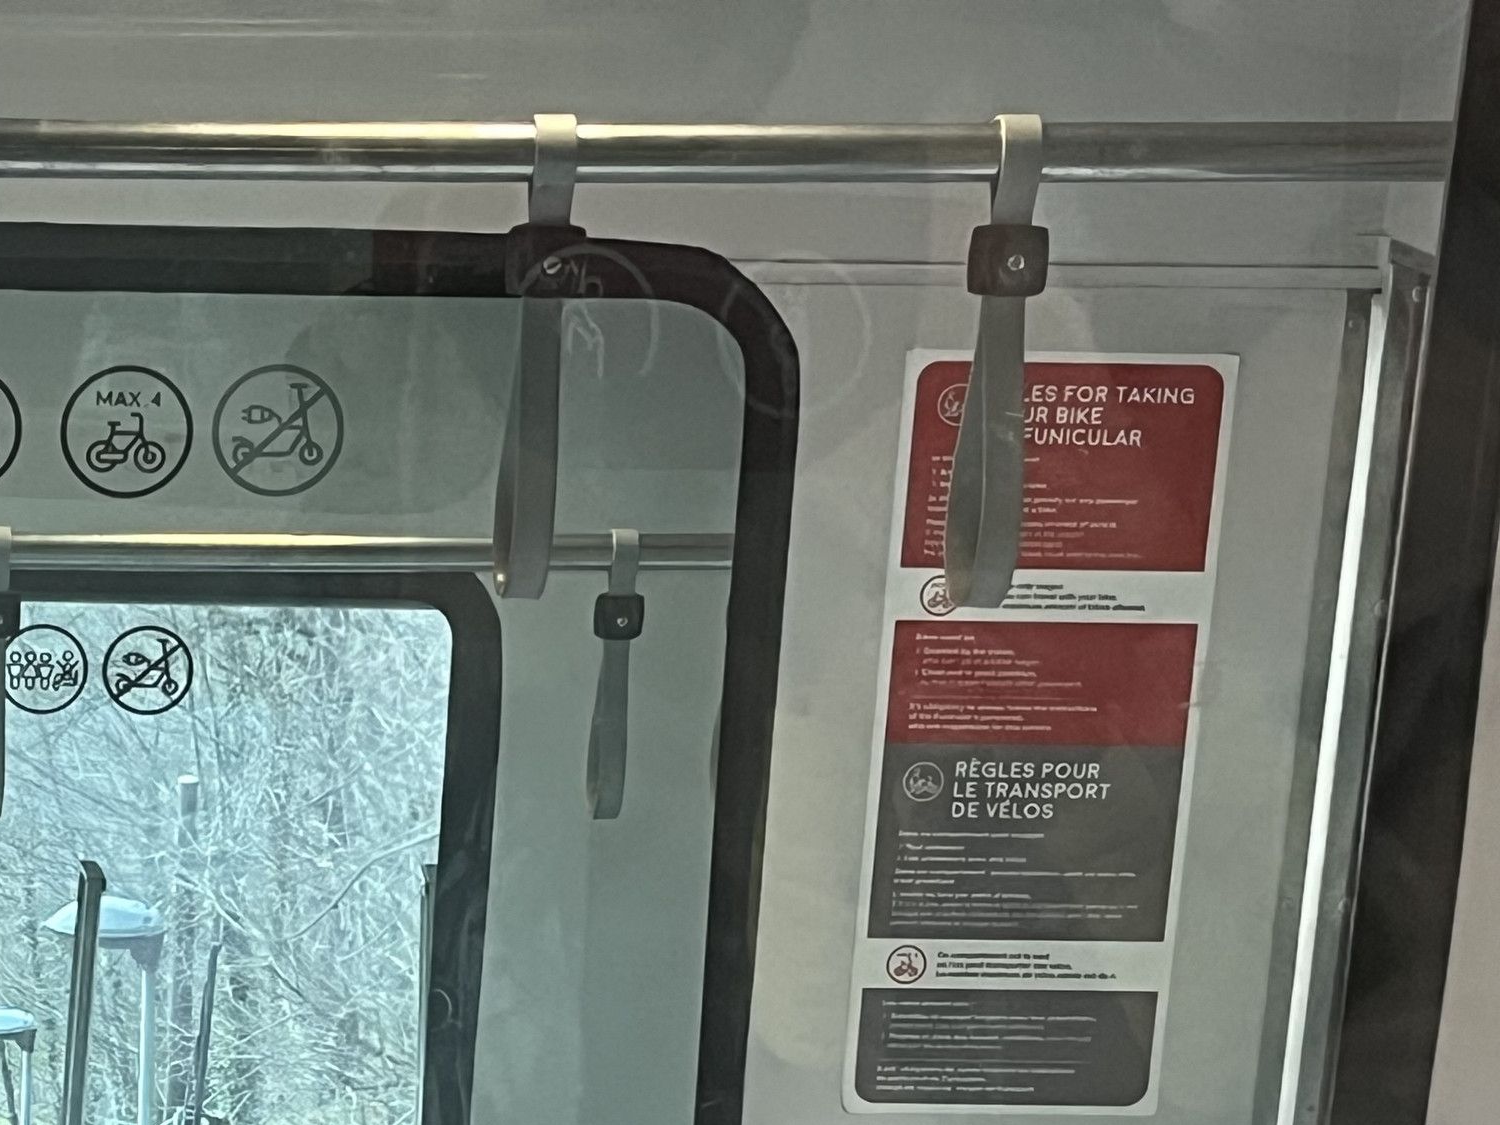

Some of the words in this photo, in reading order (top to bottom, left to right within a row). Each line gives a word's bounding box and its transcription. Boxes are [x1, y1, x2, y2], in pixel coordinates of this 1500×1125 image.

[96, 390, 141, 407] MAX
[151, 391, 162, 407] 4
[1063, 385, 1108, 403] FOR
[1116, 386, 1195, 404] TAKING
[1056, 407, 1103, 424] BIKE
[955, 758, 1035, 779] RÈGLES
[1041, 762, 1101, 779] POUR
[953, 782, 978, 799] LE
[985, 782, 1111, 800] TRANSPORT
[951, 801, 978, 818] DE
[986, 800, 1054, 819] VÉLOS
